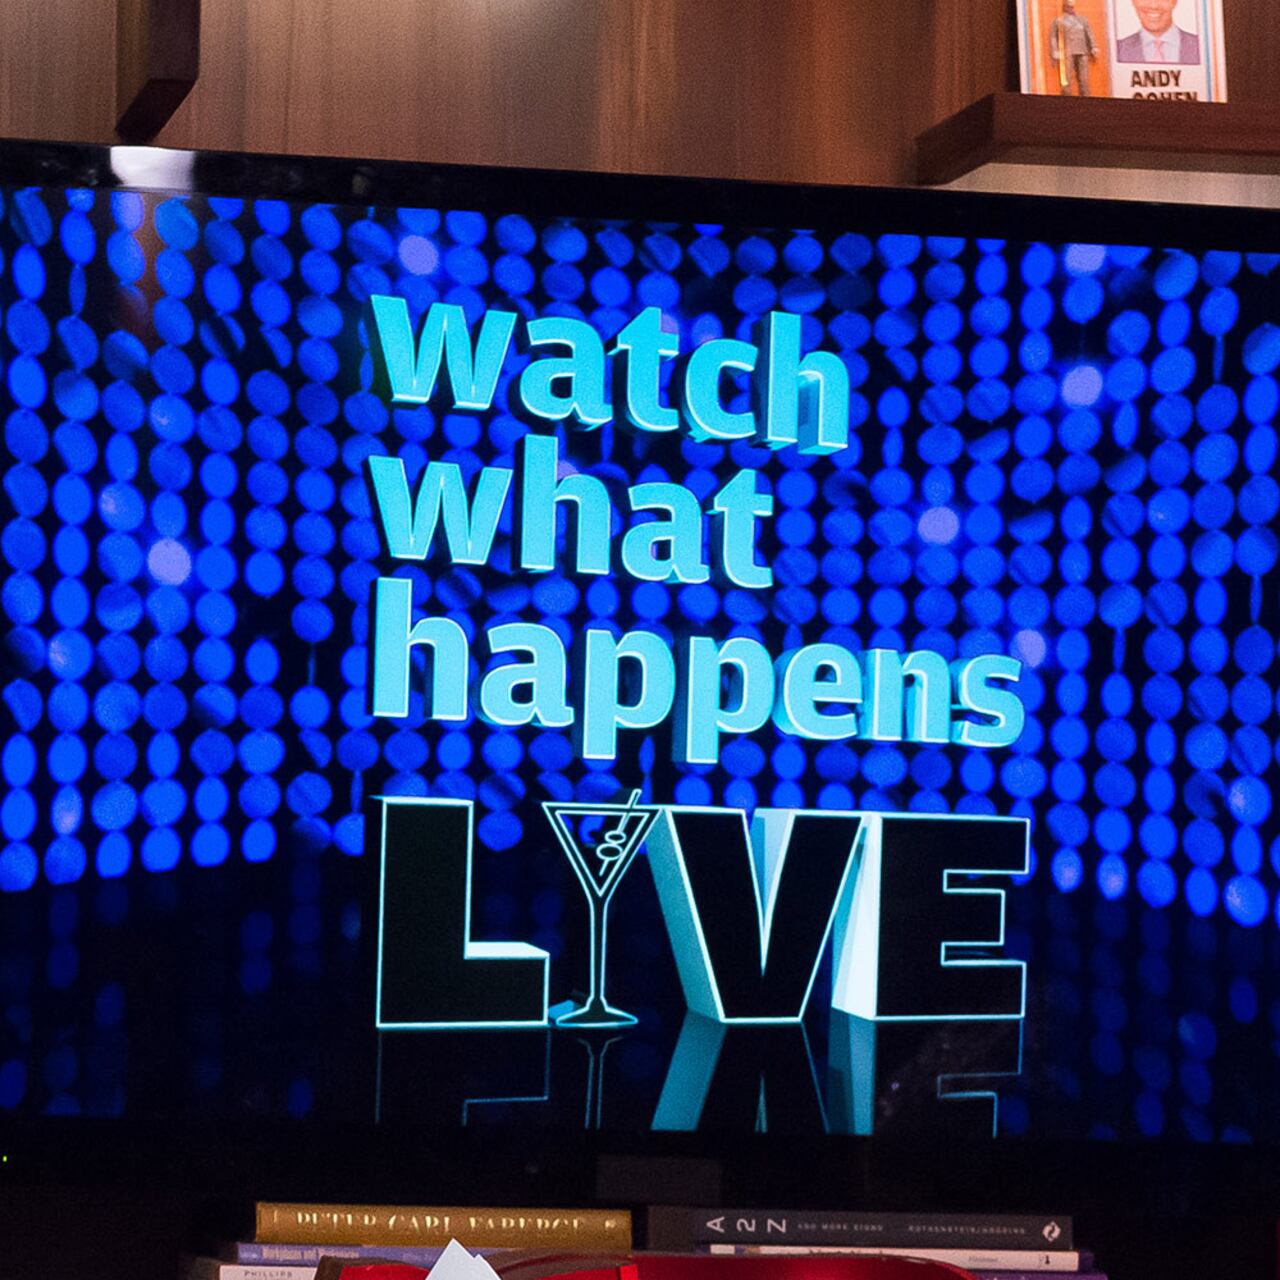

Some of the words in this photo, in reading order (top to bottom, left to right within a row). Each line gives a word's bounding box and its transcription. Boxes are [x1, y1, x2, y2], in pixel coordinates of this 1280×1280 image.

[1130, 70, 1181, 88] ANDY
[369, 294, 850, 455] watch
[367, 434, 774, 590] what
[372, 576, 1025, 764] happens
